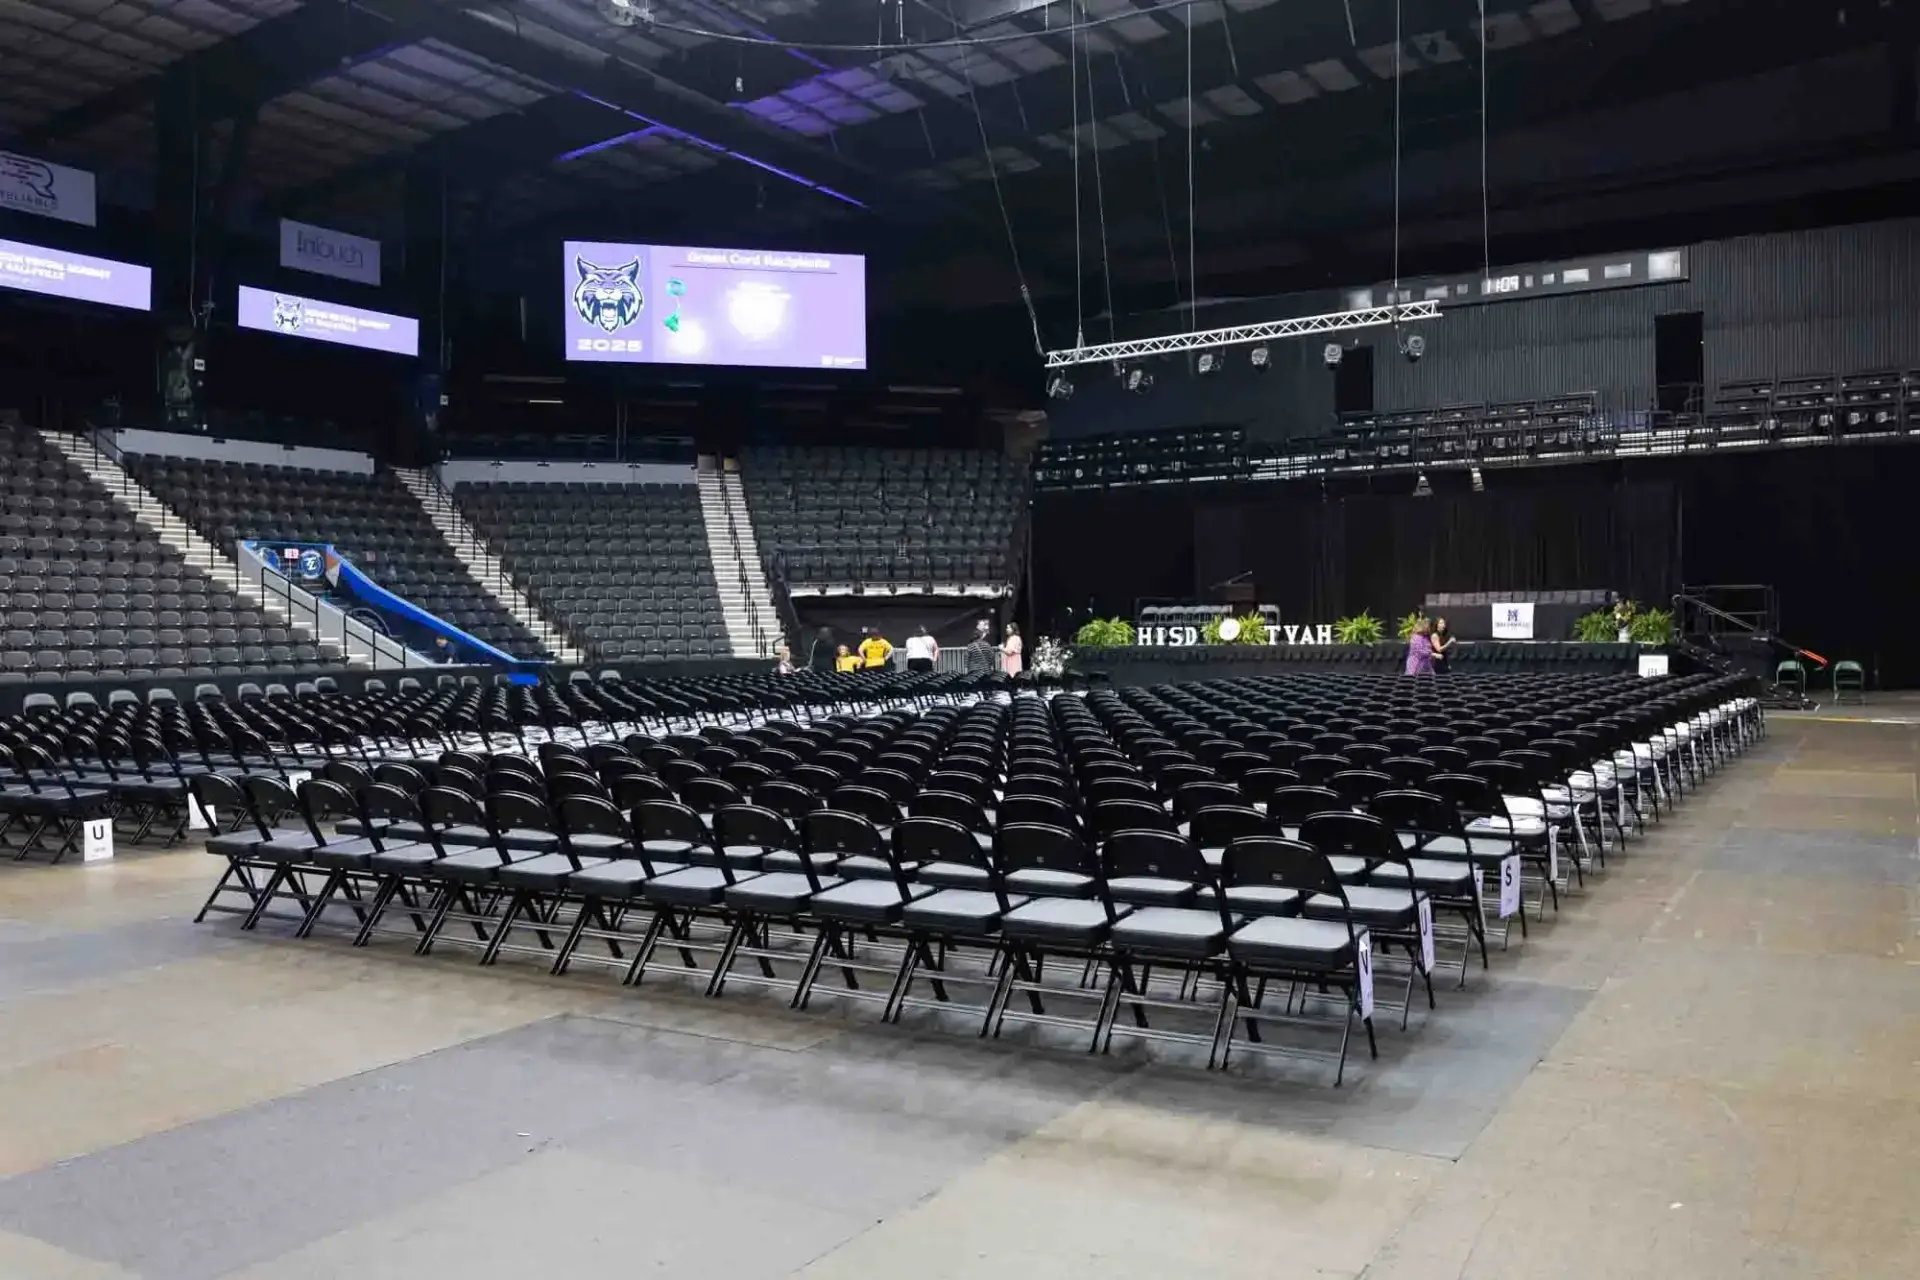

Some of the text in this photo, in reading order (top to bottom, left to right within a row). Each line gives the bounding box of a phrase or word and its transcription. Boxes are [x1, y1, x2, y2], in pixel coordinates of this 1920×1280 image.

[576, 339, 643, 352] 2025
[1137, 626, 1198, 646] HISD
[92, 824, 104, 840] U
[1505, 865, 1513, 887] S
